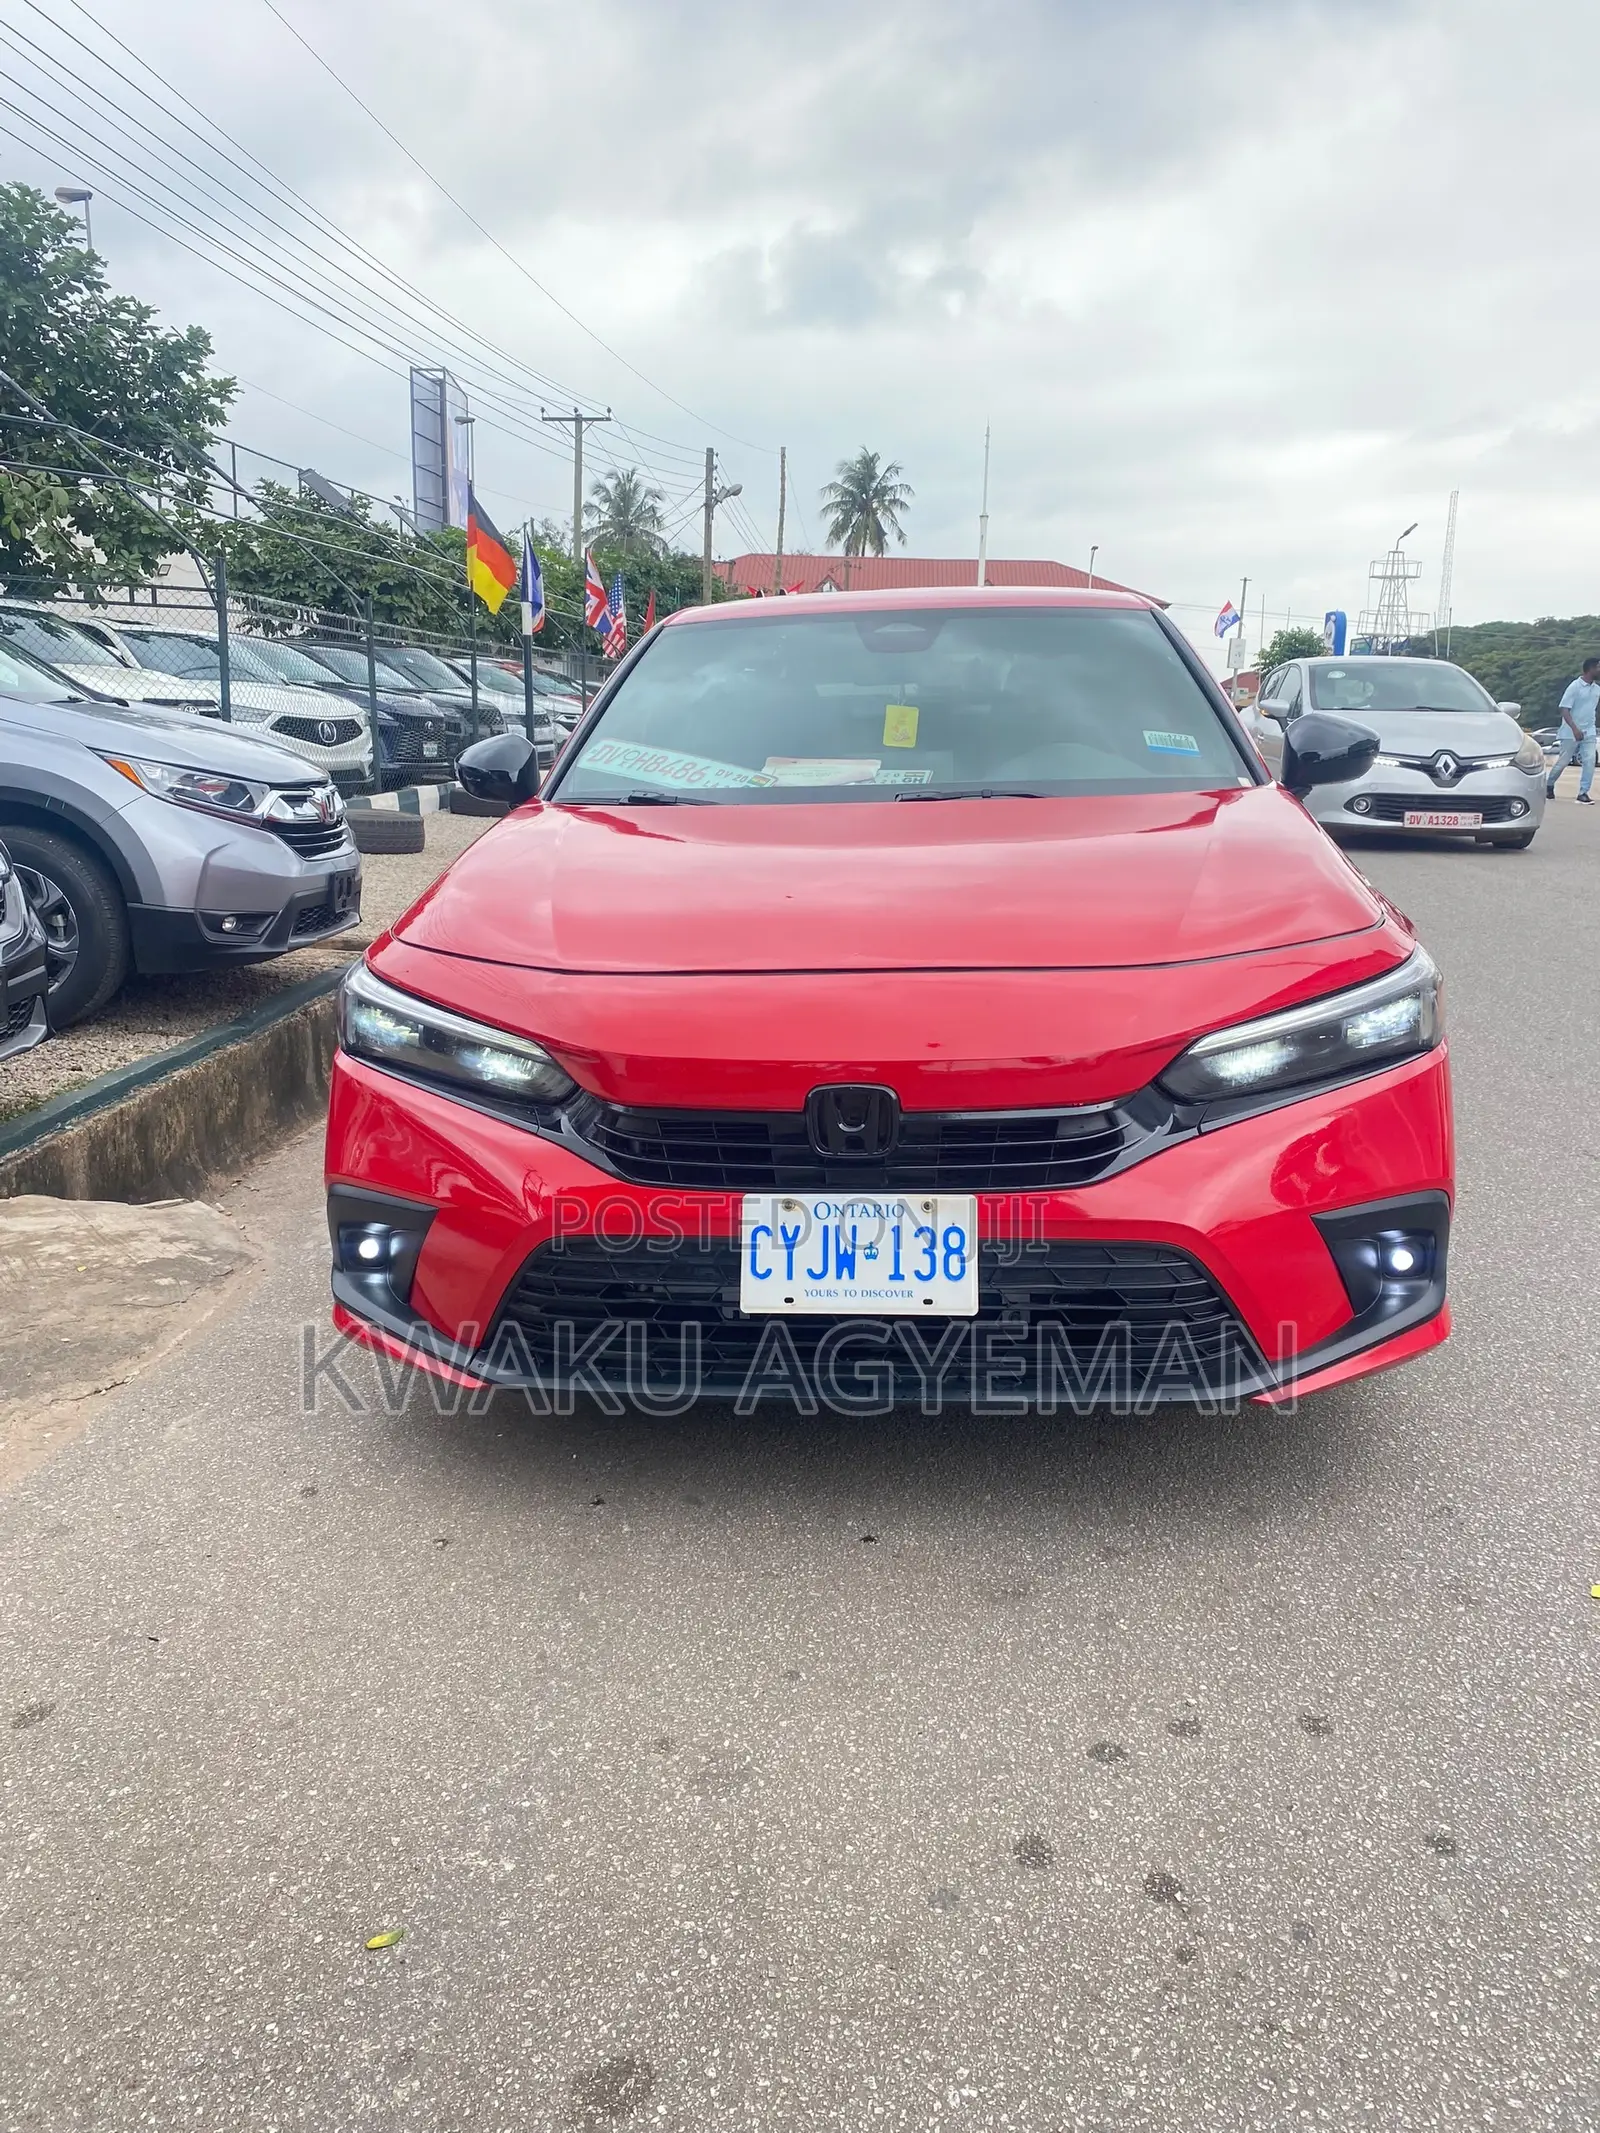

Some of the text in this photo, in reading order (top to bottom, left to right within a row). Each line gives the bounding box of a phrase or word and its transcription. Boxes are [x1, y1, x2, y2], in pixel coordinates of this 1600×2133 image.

[1409, 815, 1421, 825] DV
[1428, 815, 1458, 826] A1328
[813, 1201, 905, 1221] ONTARIO
[750, 1224, 966, 1282] CYJW 138
[804, 1288, 914, 1299] YOURS TO DISCOVER
